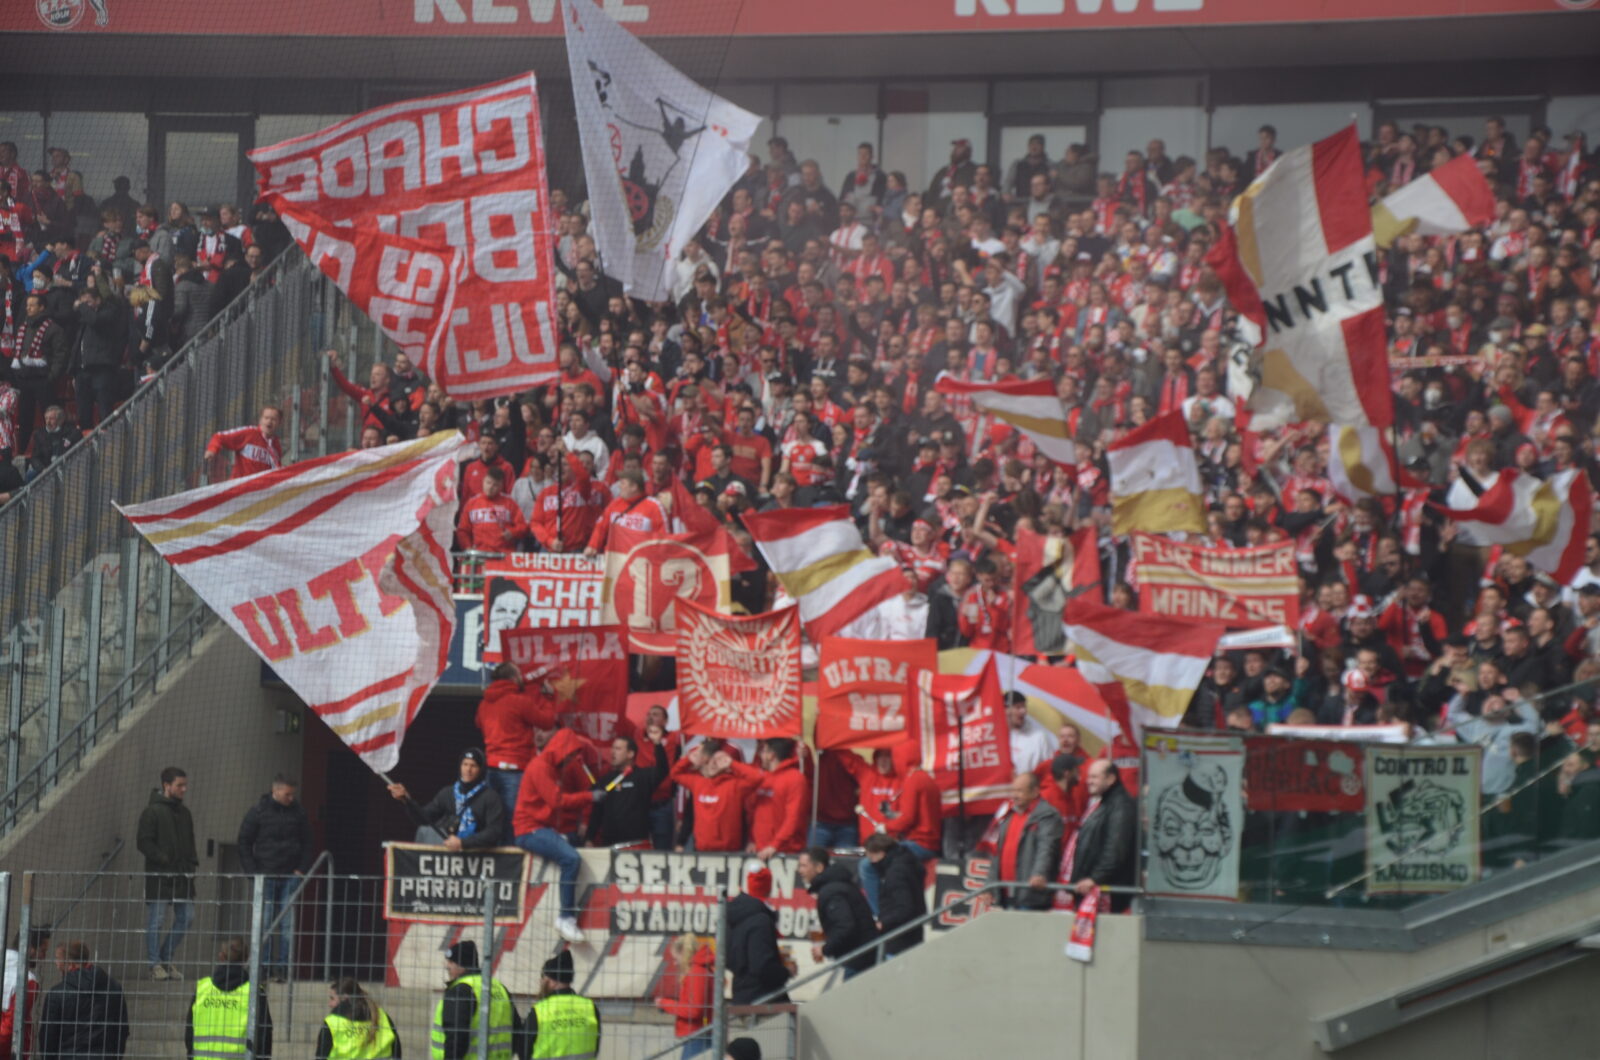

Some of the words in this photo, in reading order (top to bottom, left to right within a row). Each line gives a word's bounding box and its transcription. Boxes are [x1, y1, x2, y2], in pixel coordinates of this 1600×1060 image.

[1202, 545, 1295, 575] IMMER
[628, 556, 703, 633] 12
[1151, 587, 1238, 620] MAINZ
[507, 630, 626, 664] ULTRA
[848, 693, 905, 731] MZ
[1374, 757, 1447, 775] CONTRO
[1452, 757, 1469, 775] IL
[419, 855, 495, 877] CURVA
[400, 877, 513, 901] PARADIO
[203, 997, 238, 1010] ORDNER
[552, 1017, 587, 1030] ORDNER
